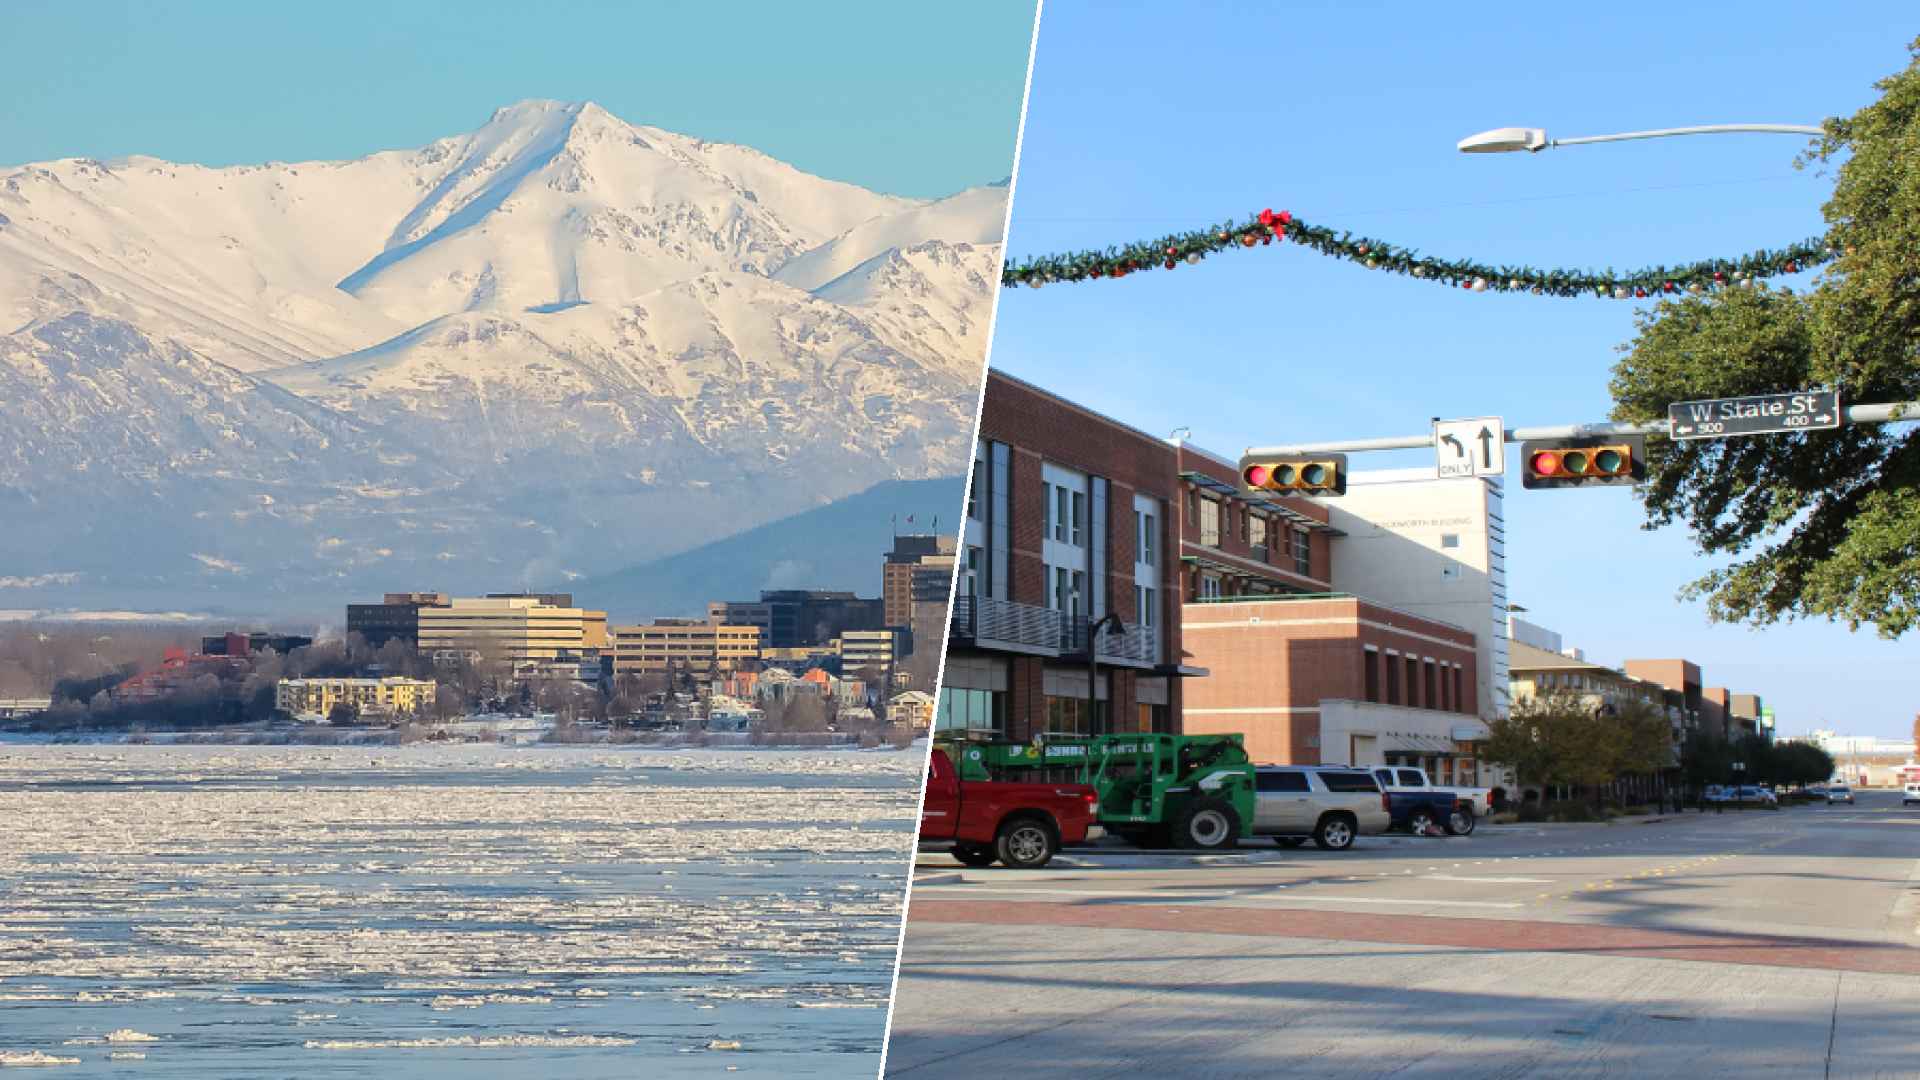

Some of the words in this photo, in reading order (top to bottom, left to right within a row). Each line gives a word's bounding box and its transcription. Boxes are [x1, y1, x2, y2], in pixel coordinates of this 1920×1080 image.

[1690, 406, 1712, 421] W
[1721, 401, 1784, 420] State
[1791, 395, 1816, 414] St
[1783, 415, 1809, 426] 400
[1698, 422, 1724, 434] 500
[1440, 463, 1471, 474] ONLY
